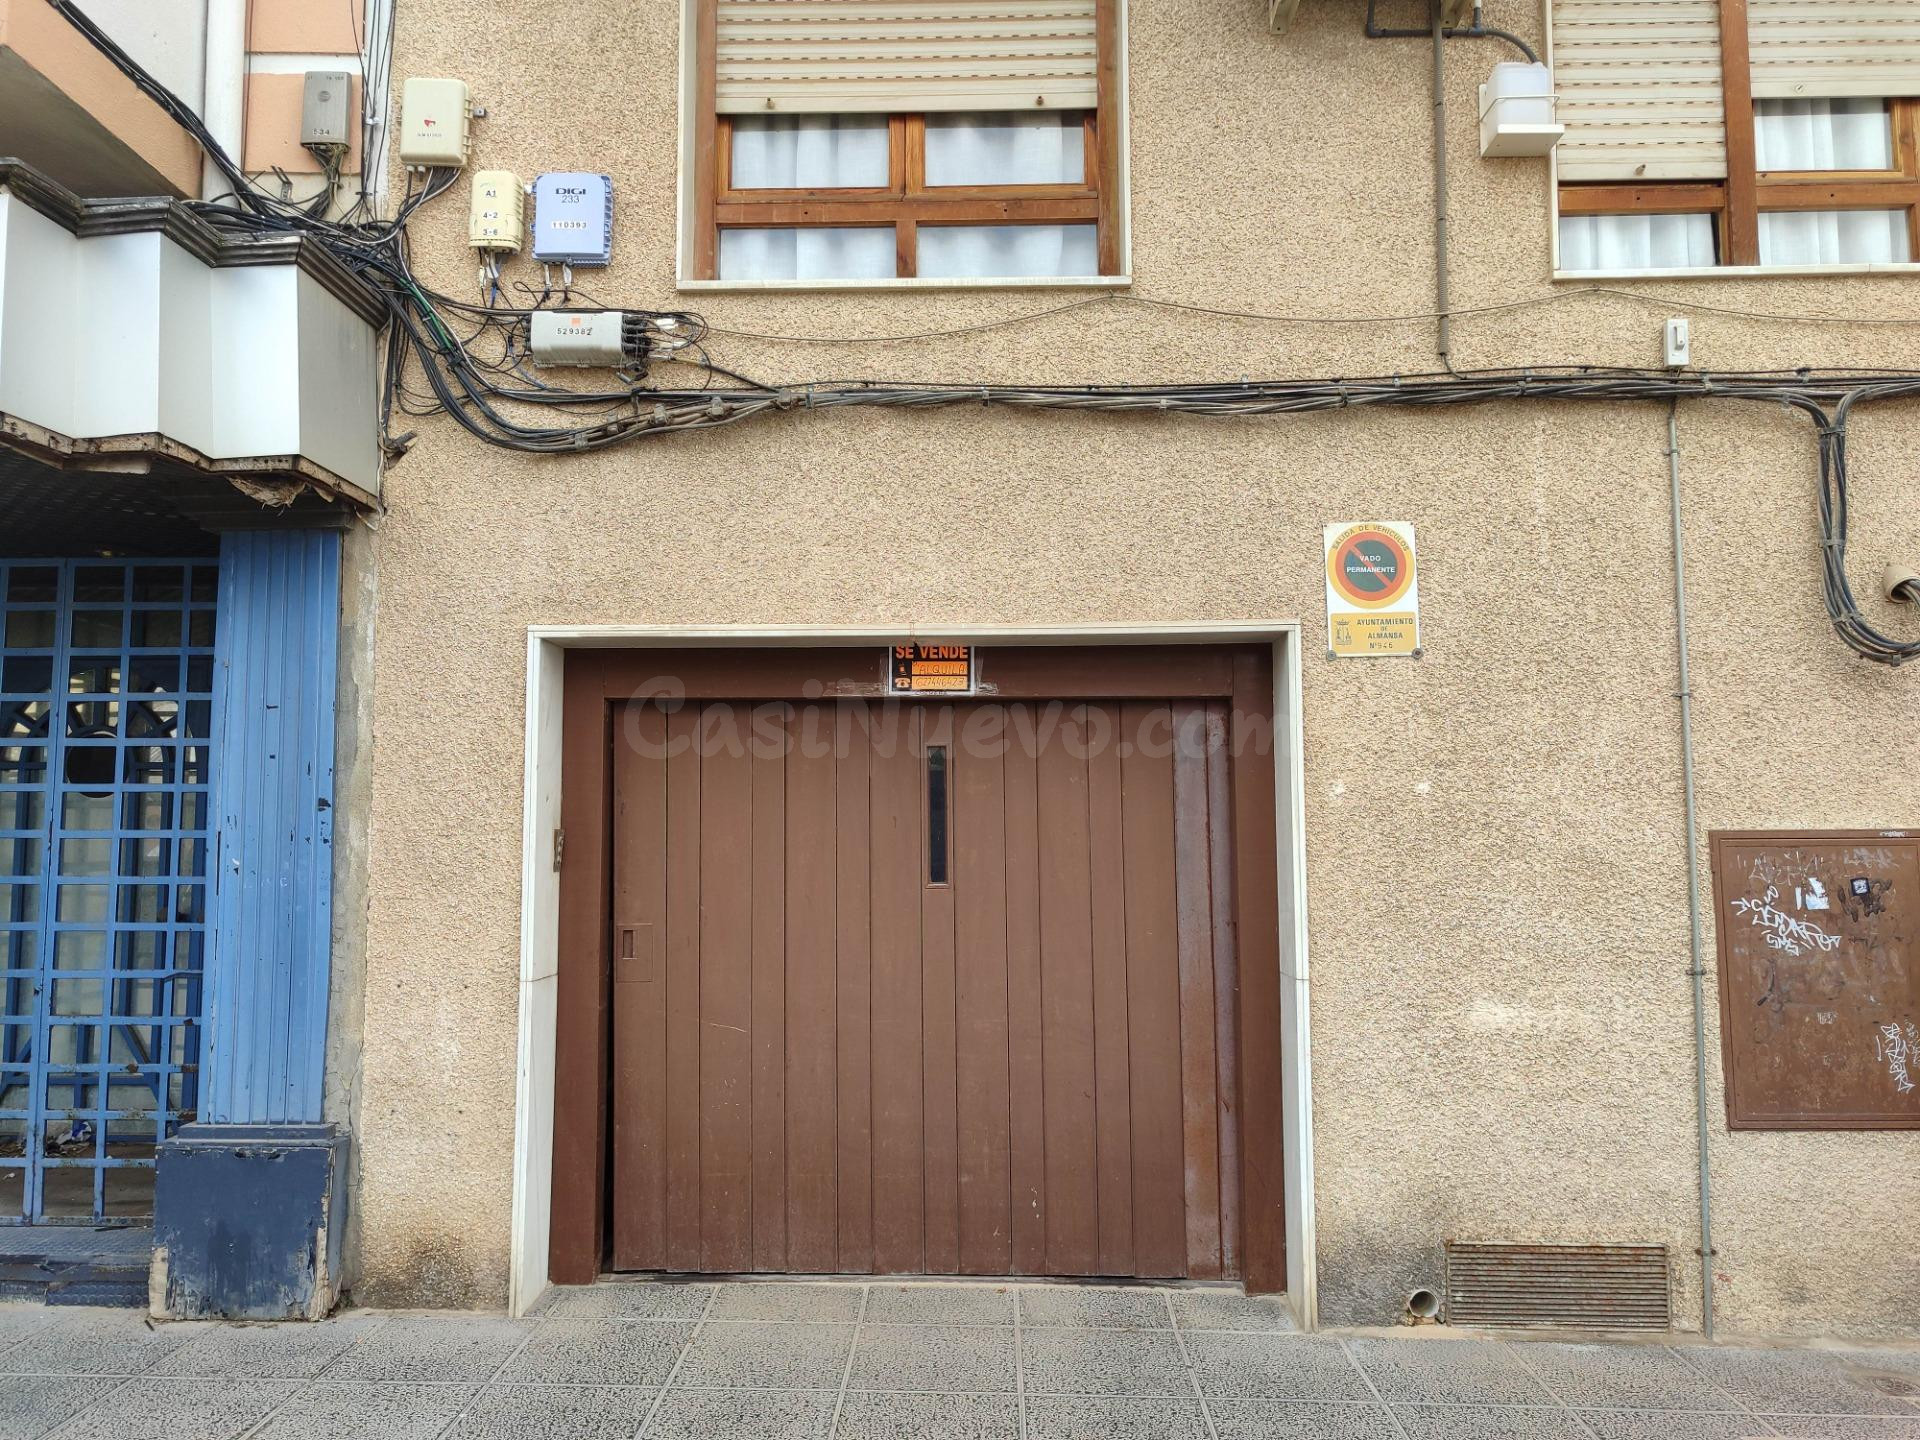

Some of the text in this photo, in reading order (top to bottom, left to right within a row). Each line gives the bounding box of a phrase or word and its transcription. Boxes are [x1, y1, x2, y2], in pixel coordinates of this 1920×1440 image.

[555, 187, 587, 195] DIGI
[561, 194, 580, 204] 233
[1332, 524, 1410, 552] SALIDA DE VEHICULOS
[1356, 617, 1414, 626] AYUNTAMIENTO
[1367, 632, 1404, 640] ALMANSA
[895, 645, 968, 659] SE VENDE
